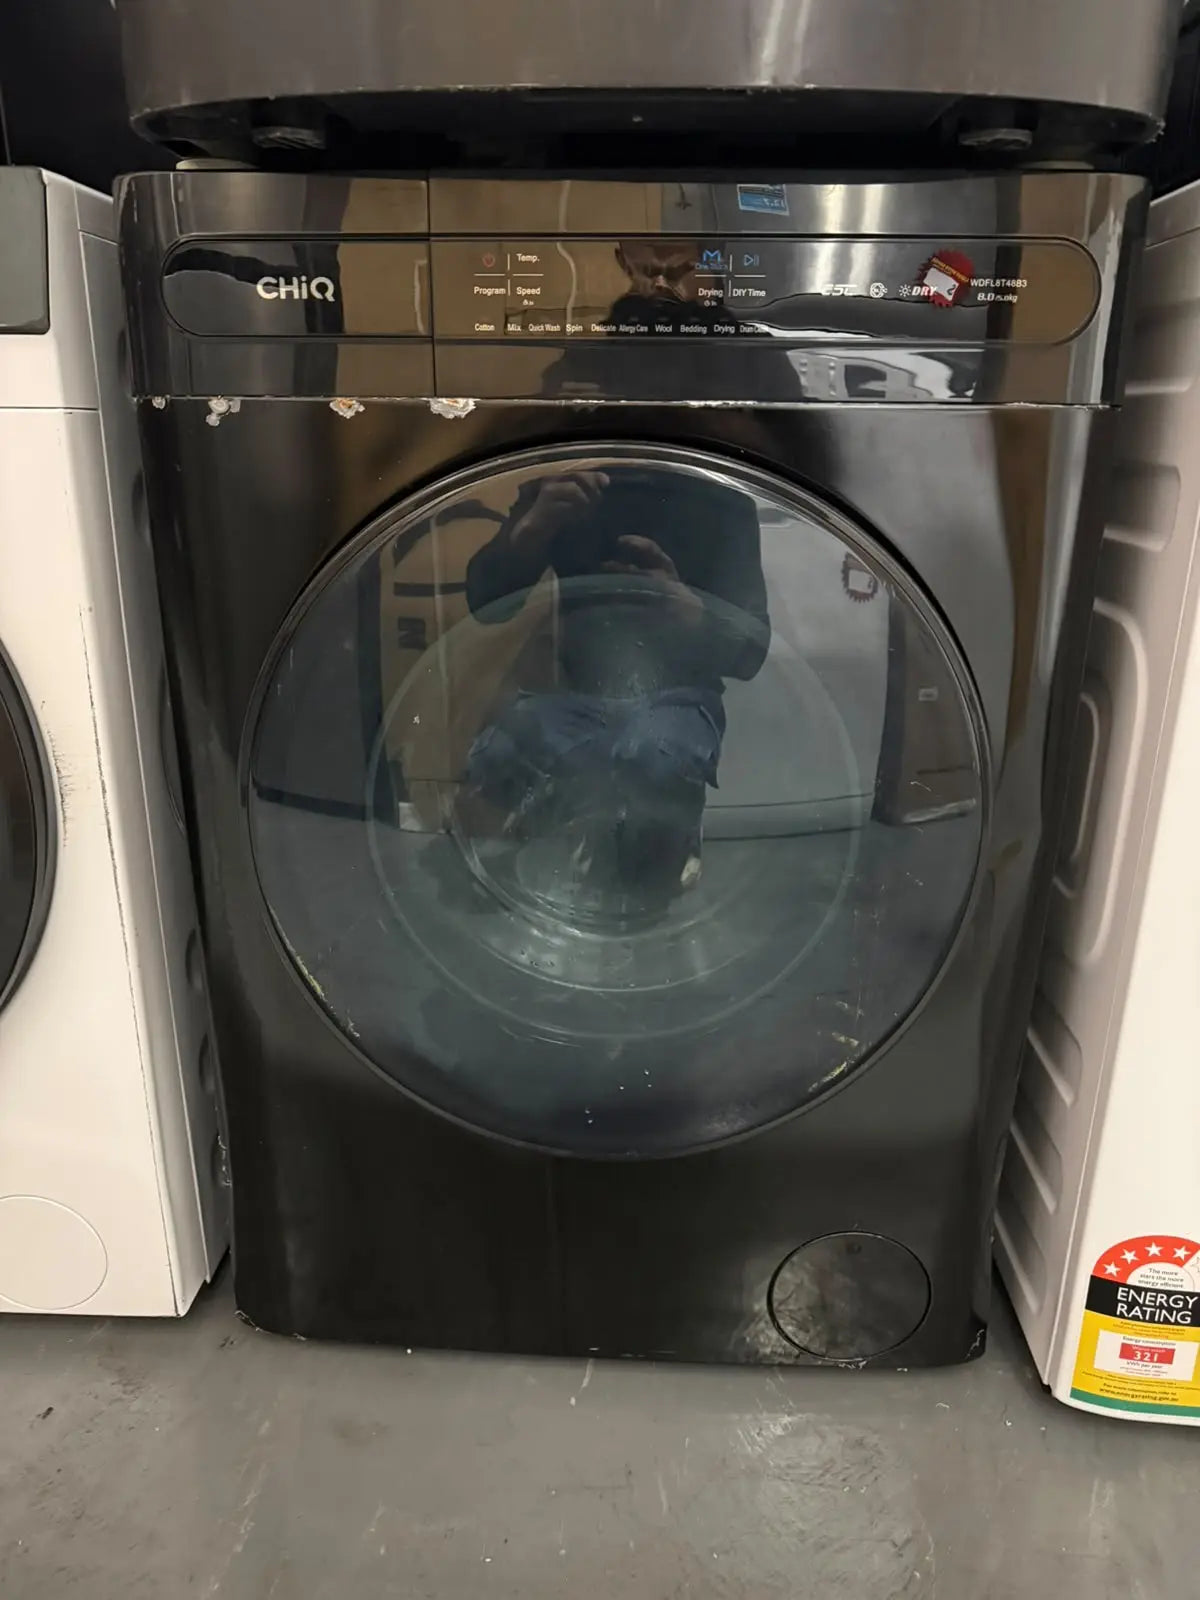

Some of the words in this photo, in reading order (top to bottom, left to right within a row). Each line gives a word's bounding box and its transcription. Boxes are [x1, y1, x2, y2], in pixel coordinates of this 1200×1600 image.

[516, 253, 540, 263] Temp.
[256, 275, 335, 302] CHiQ
[473, 286, 506, 296] Program
[516, 286, 541, 296] Speed
[698, 288, 723, 298] Drying
[732, 288, 747, 297] DIY
[748, 288, 766, 297] Time
[912, 286, 938, 296] DRY
[474, 323, 495, 332] Cotton
[507, 323, 522, 332] Mix
[528, 323, 544, 332] Quick
[545, 323, 561, 332] Wash
[566, 323, 583, 333] Spin
[591, 323, 616, 332] Delicate
[655, 324, 673, 333] Wool
[680, 324, 707, 334] Bedding
[713, 324, 736, 334] Drying
[1117, 1286, 1198, 1309] ENERGY
[1116, 1302, 1192, 1324] RATING
[1133, 1351, 1159, 1362] 321
